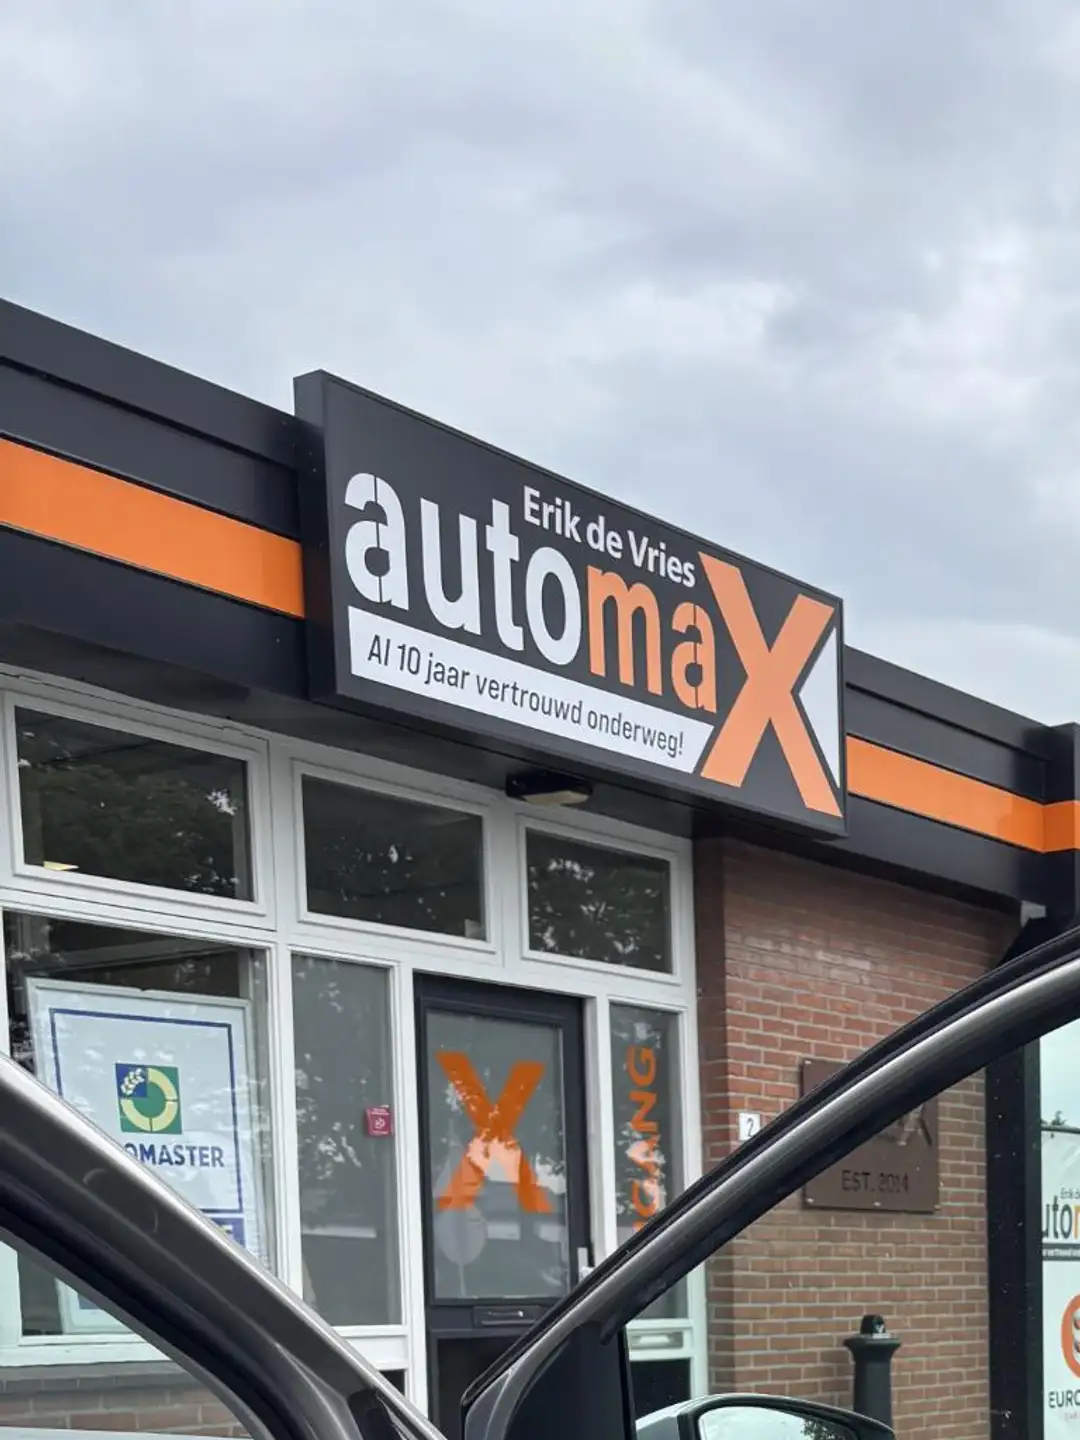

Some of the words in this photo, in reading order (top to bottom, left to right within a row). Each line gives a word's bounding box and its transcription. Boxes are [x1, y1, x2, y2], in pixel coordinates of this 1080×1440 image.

[523, 485, 582, 543] Erik
[586, 515, 623, 559] de
[627, 530, 696, 588] Vries
[343, 472, 844, 818] automaX
[367, 634, 391, 667] Al
[397, 643, 421, 676] 10
[424, 652, 470, 690] jaar
[476, 674, 584, 726] vertrouwd
[587, 711, 685, 759] onderweg!
[124, 1142, 225, 1168] OMASTER
[627, 1046, 665, 1233] GANG
